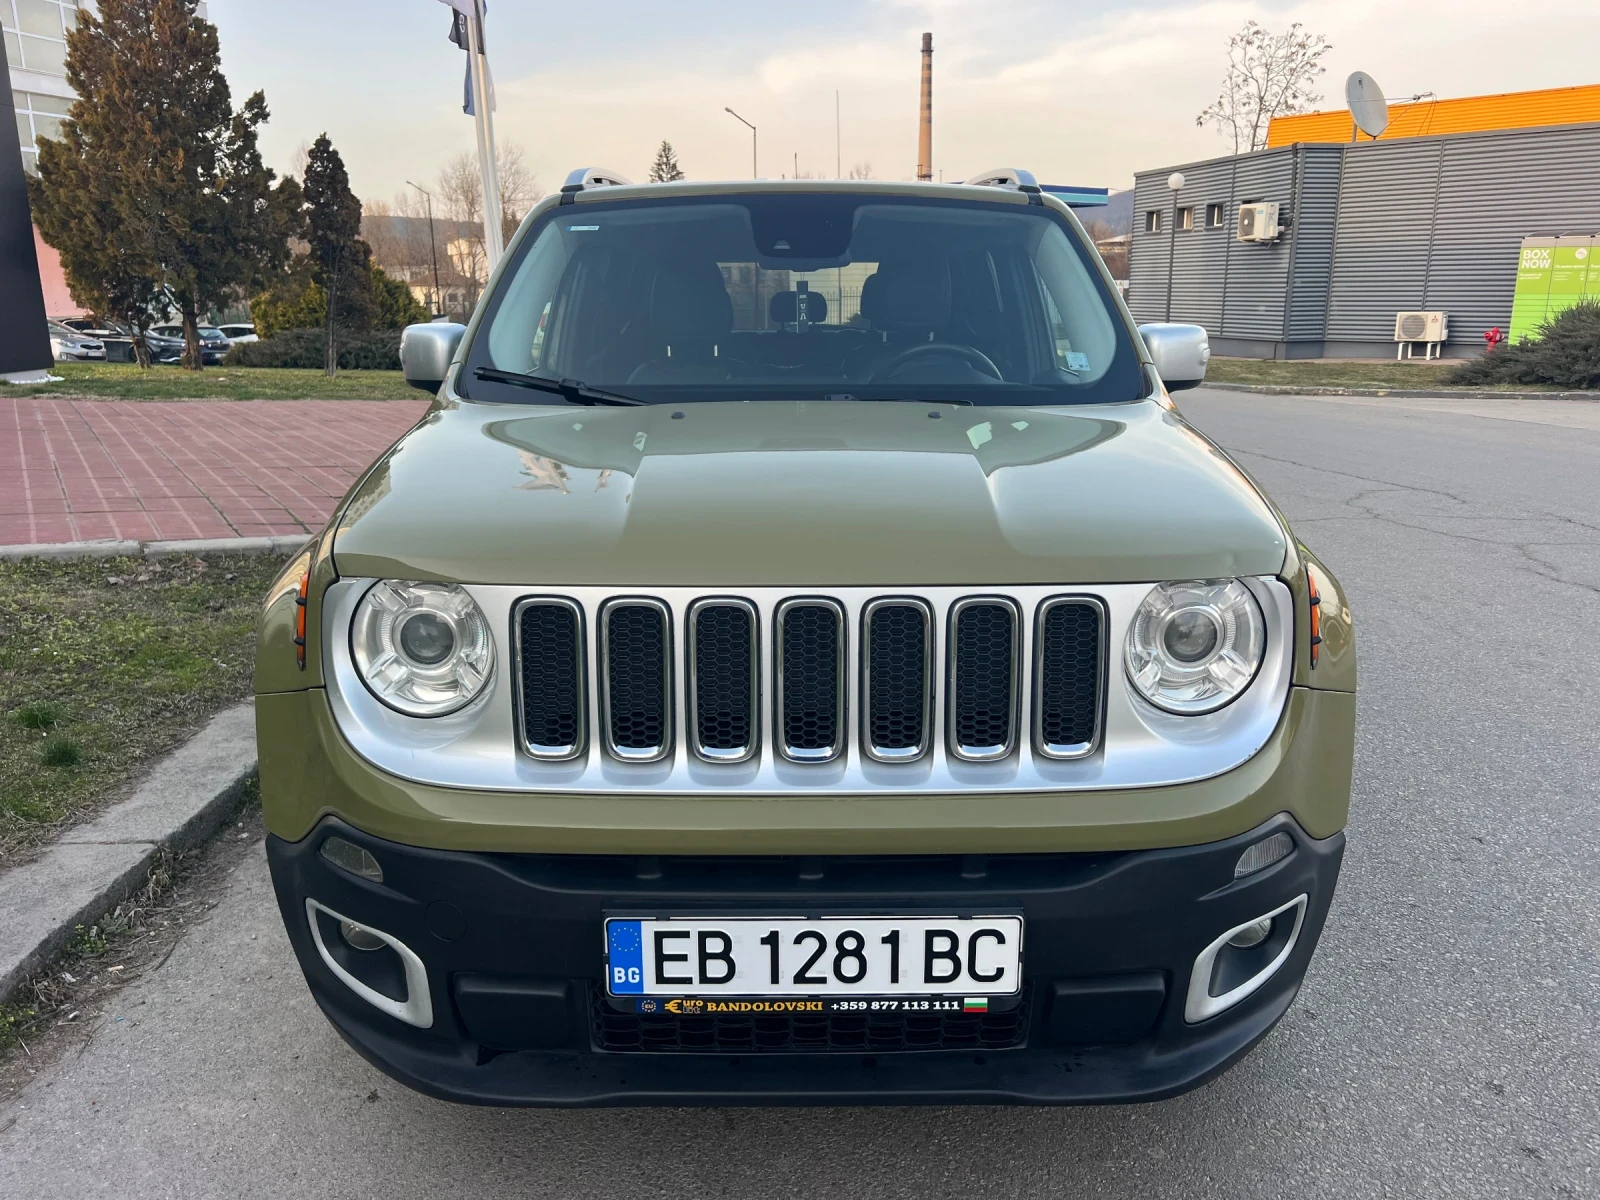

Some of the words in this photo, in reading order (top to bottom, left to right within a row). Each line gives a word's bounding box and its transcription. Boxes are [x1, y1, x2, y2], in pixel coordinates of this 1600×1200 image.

[1523, 249, 1550, 259] BOX
[1521, 259, 1551, 269] NOW
[653, 929, 737, 985] EB
[760, 929, 900, 985] 1281
[924, 928, 1006, 984] BC
[613, 966, 641, 984] BG
[706, 1001, 823, 1012] BANDOLOVSKI
[830, 1001, 868, 1010] +359
[870, 1001, 899, 1010] 877
[901, 1001, 930, 1010] 113
[932, 1001, 960, 1010] 111
